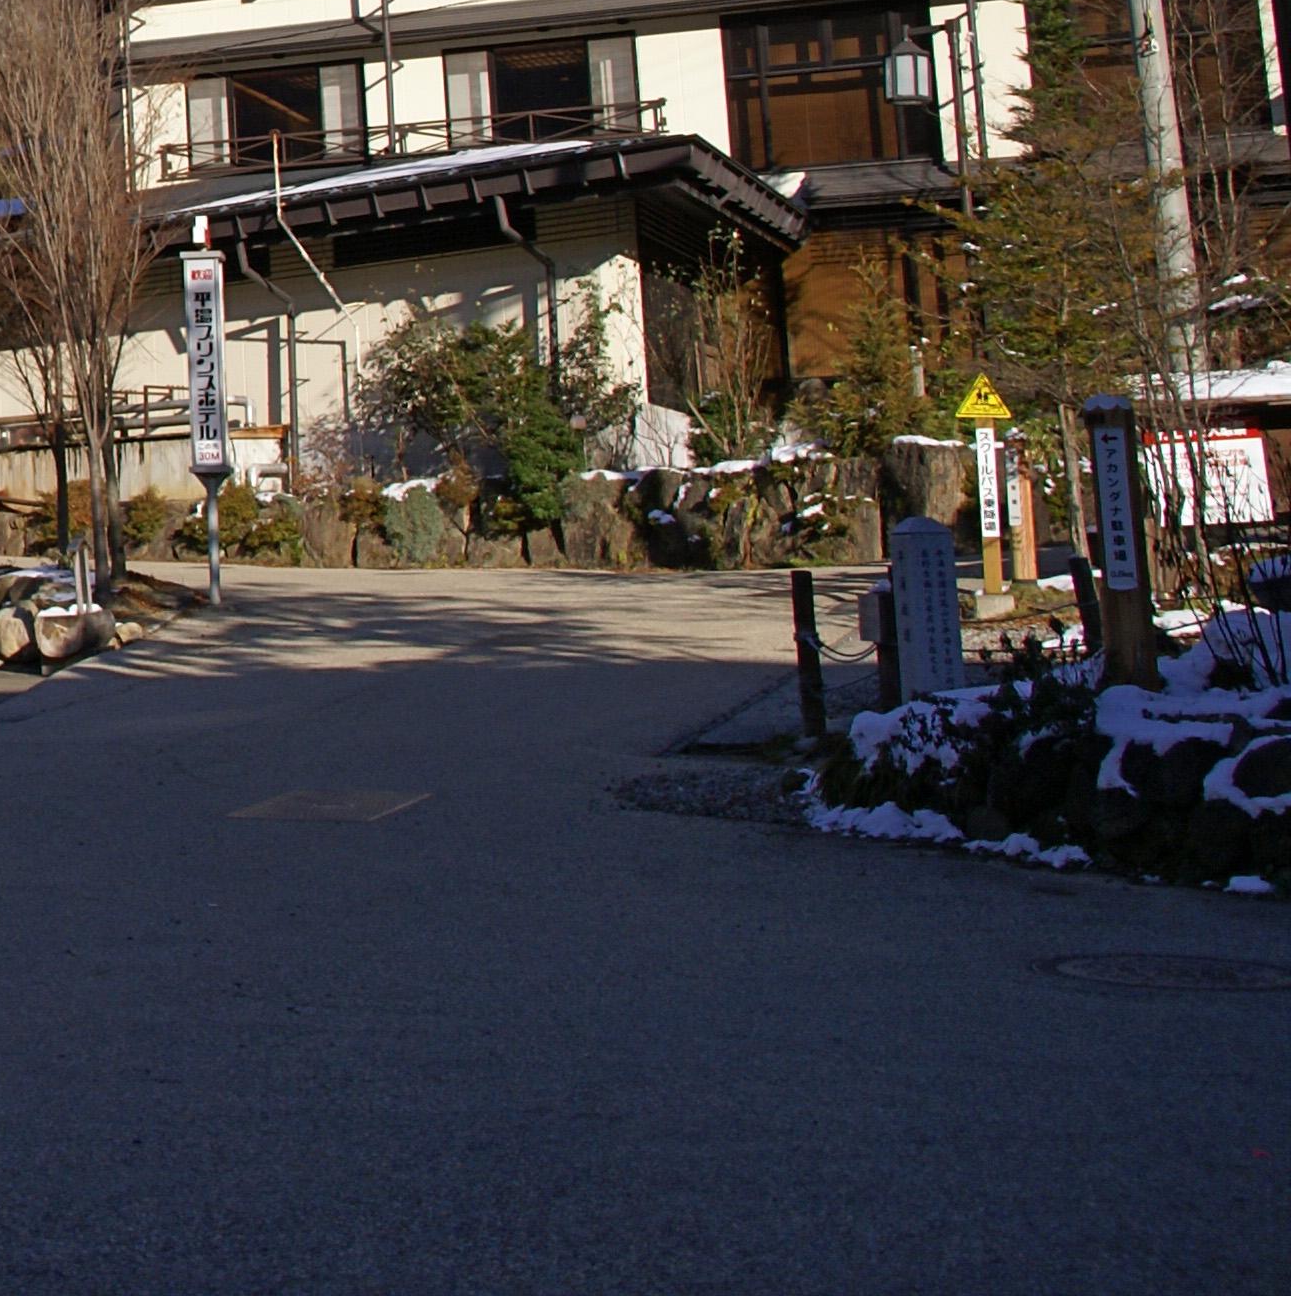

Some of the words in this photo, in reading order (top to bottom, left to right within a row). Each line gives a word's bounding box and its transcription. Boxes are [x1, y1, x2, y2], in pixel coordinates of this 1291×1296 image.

[193, 292, 218, 441] 平湯プリンスホテル
[1105, 448, 1128, 561] アカンダナ駐車場
